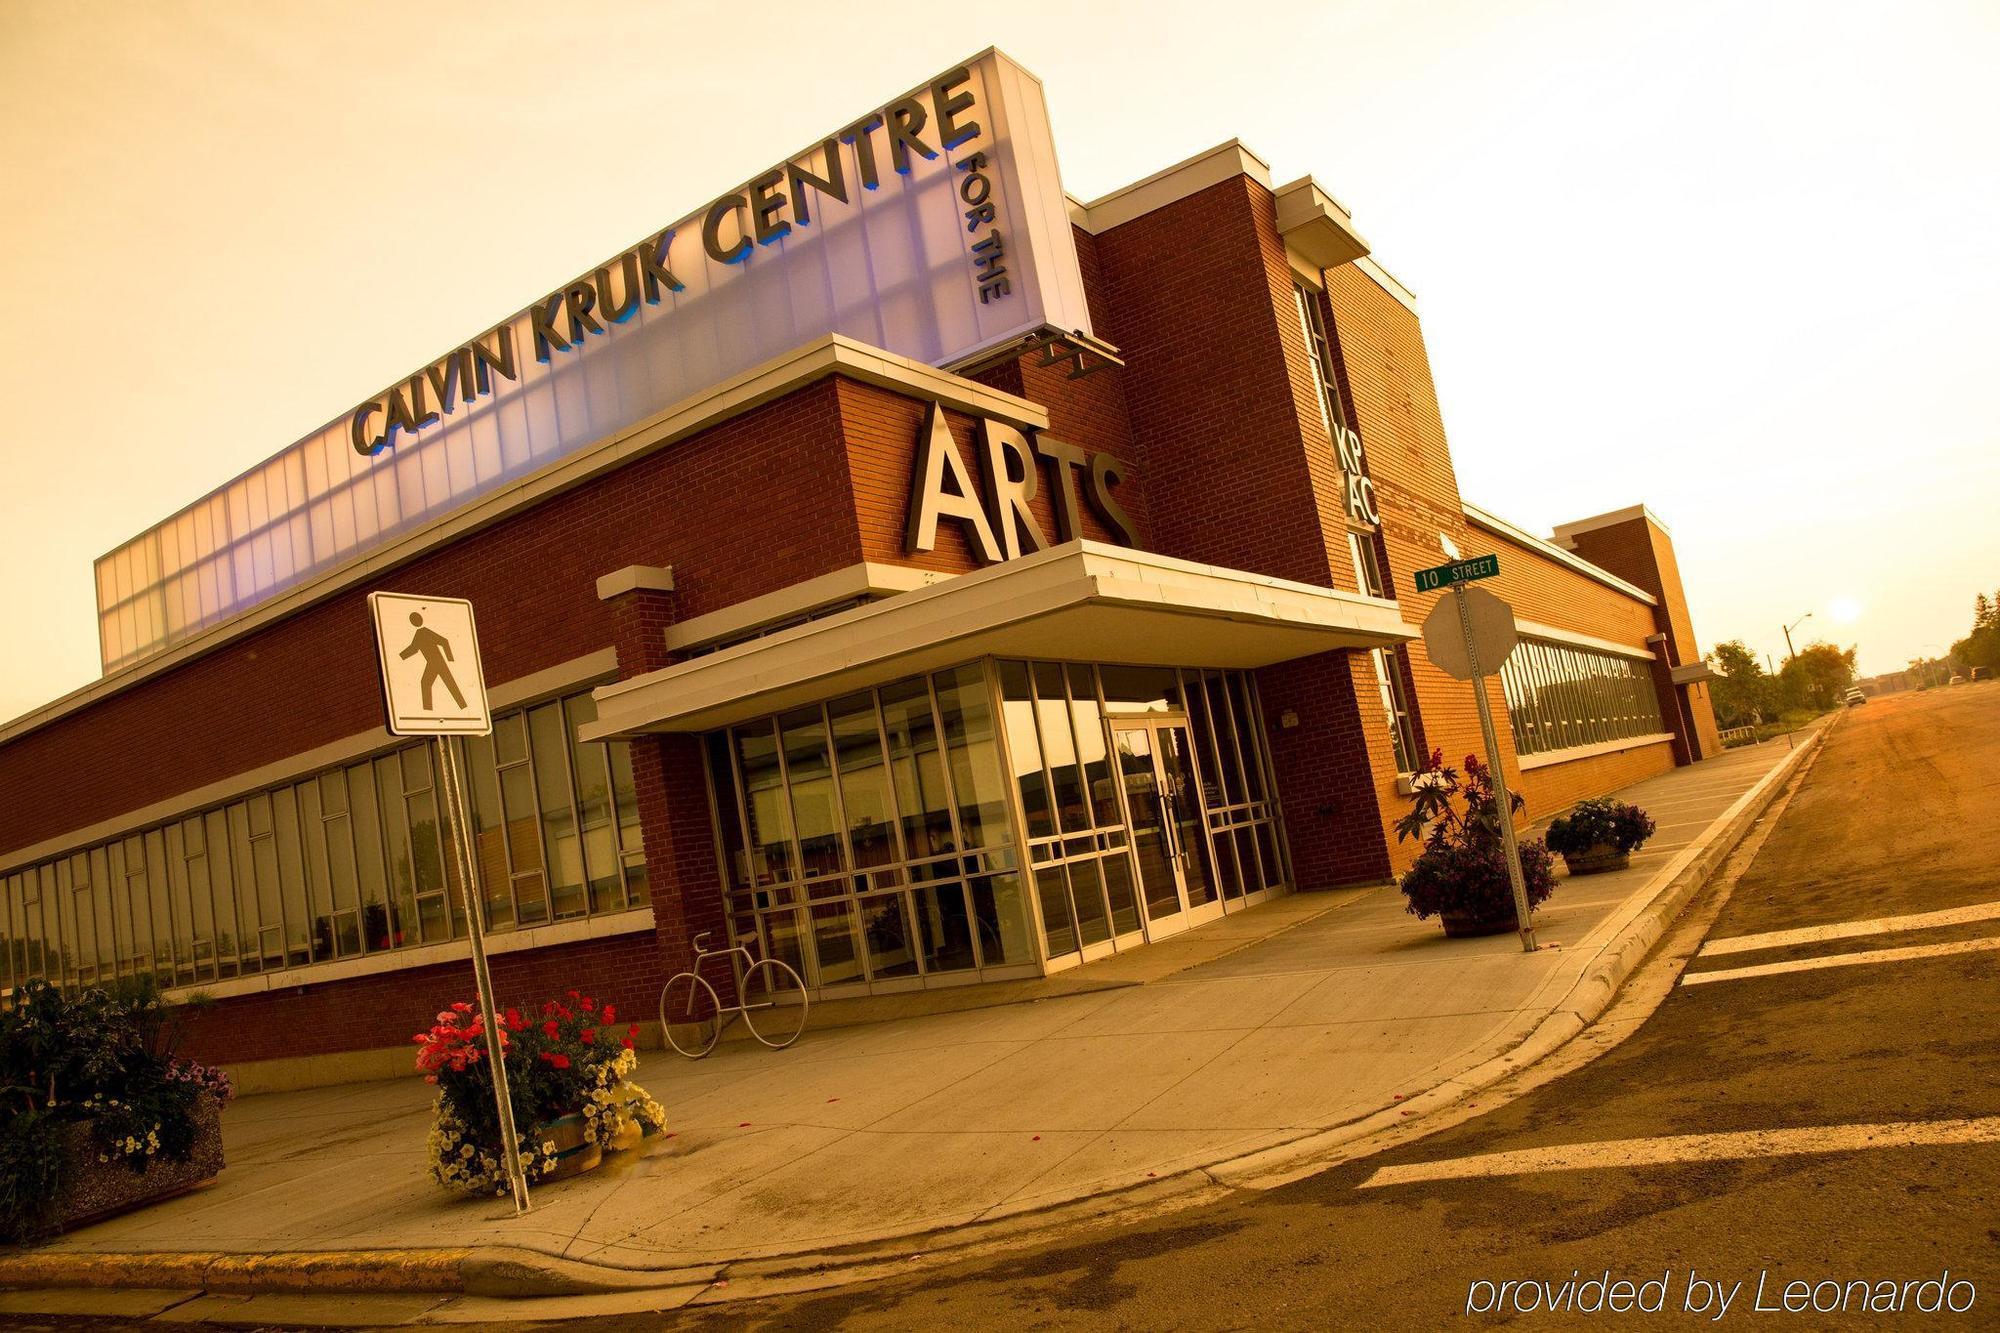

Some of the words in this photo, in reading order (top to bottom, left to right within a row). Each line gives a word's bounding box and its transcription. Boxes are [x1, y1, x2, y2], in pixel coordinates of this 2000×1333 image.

[956, 152, 995, 232] FOR
[352, 323, 517, 457] CALVIN
[530, 228, 686, 364] KRUK
[702, 66, 982, 265] CENTRE
[971, 229, 1011, 304] THE
[910, 400, 1142, 561] ARTS
[1331, 423, 1362, 475] KP
[1347, 470, 1380, 525] AC
[1421, 571, 1439, 589] 10
[1451, 559, 1493, 581] STREET
